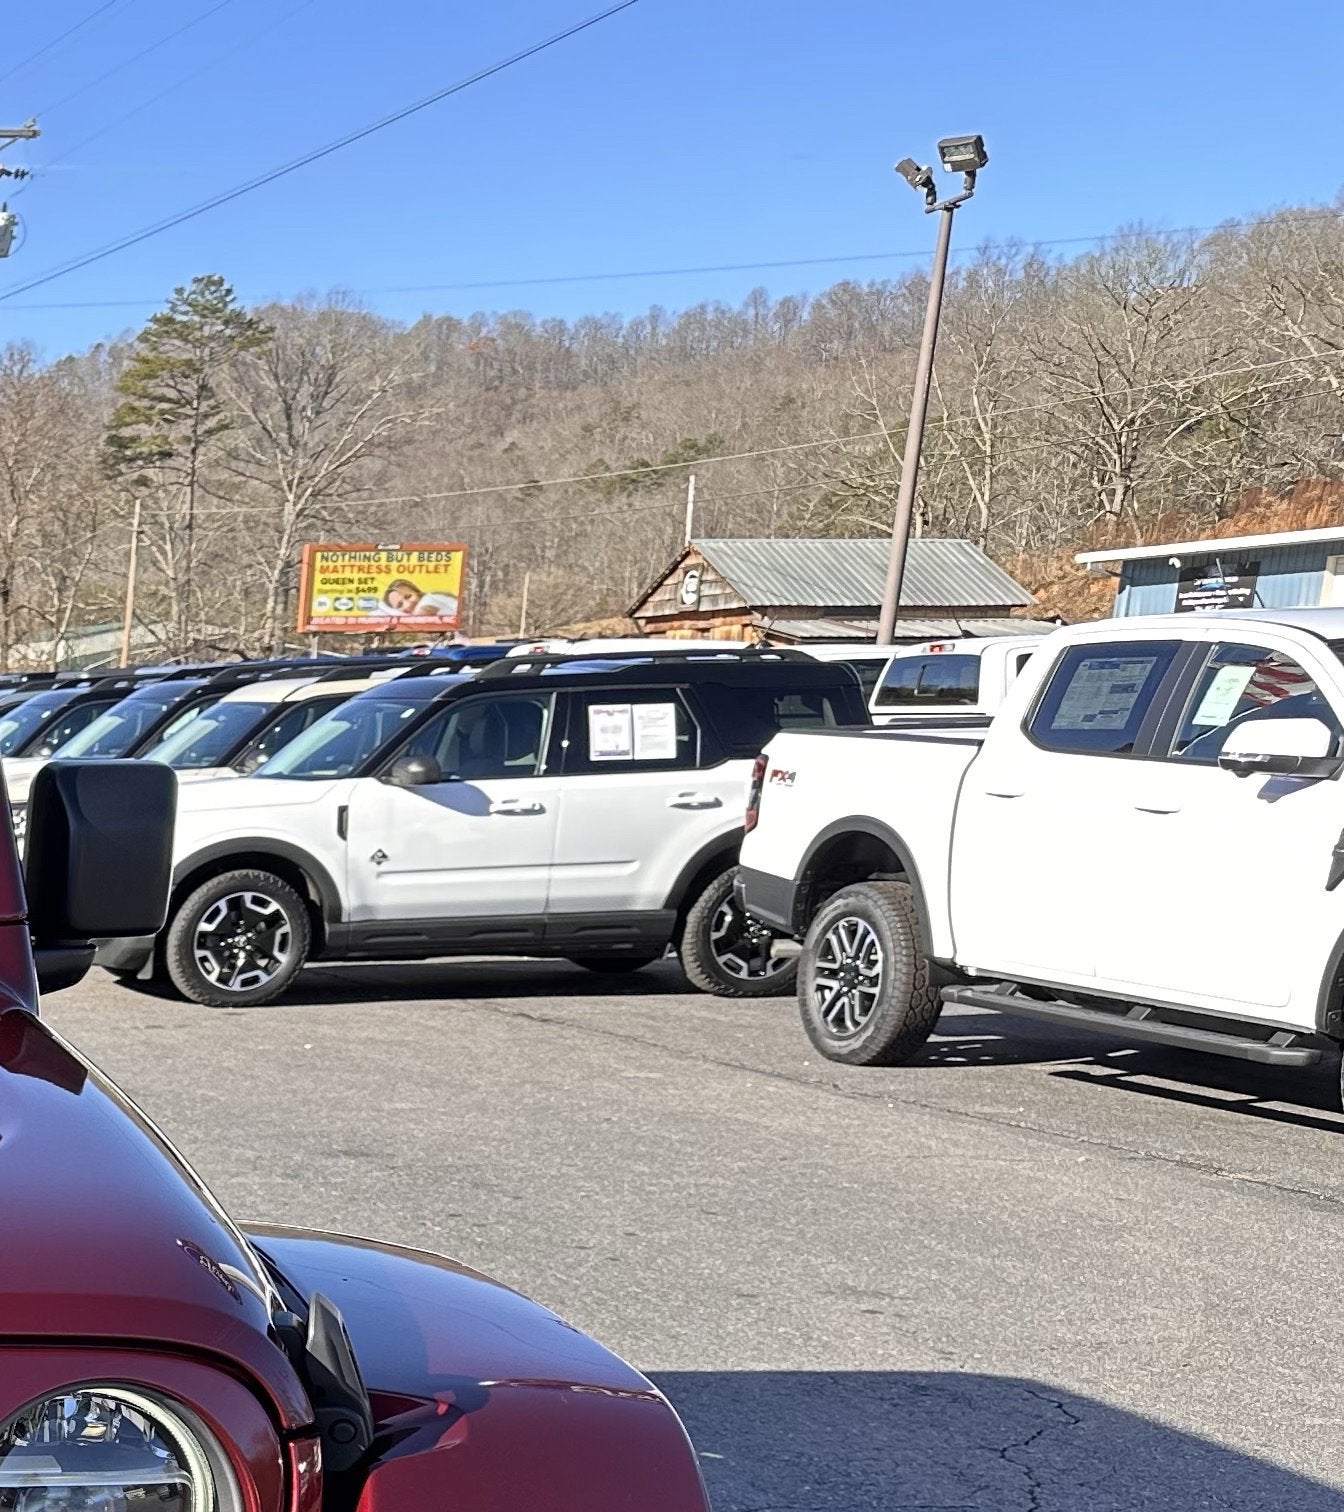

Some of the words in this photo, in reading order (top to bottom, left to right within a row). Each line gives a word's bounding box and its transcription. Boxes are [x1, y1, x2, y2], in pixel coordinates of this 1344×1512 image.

[320, 551, 381, 563] NOTHING
[386, 551, 413, 563] BUT
[417, 551, 452, 563] BEDS
[319, 564, 392, 575] MATTRESS
[396, 563, 451, 574] OUTLET
[320, 577, 354, 586] QUEEN
[357, 577, 376, 585] SET
